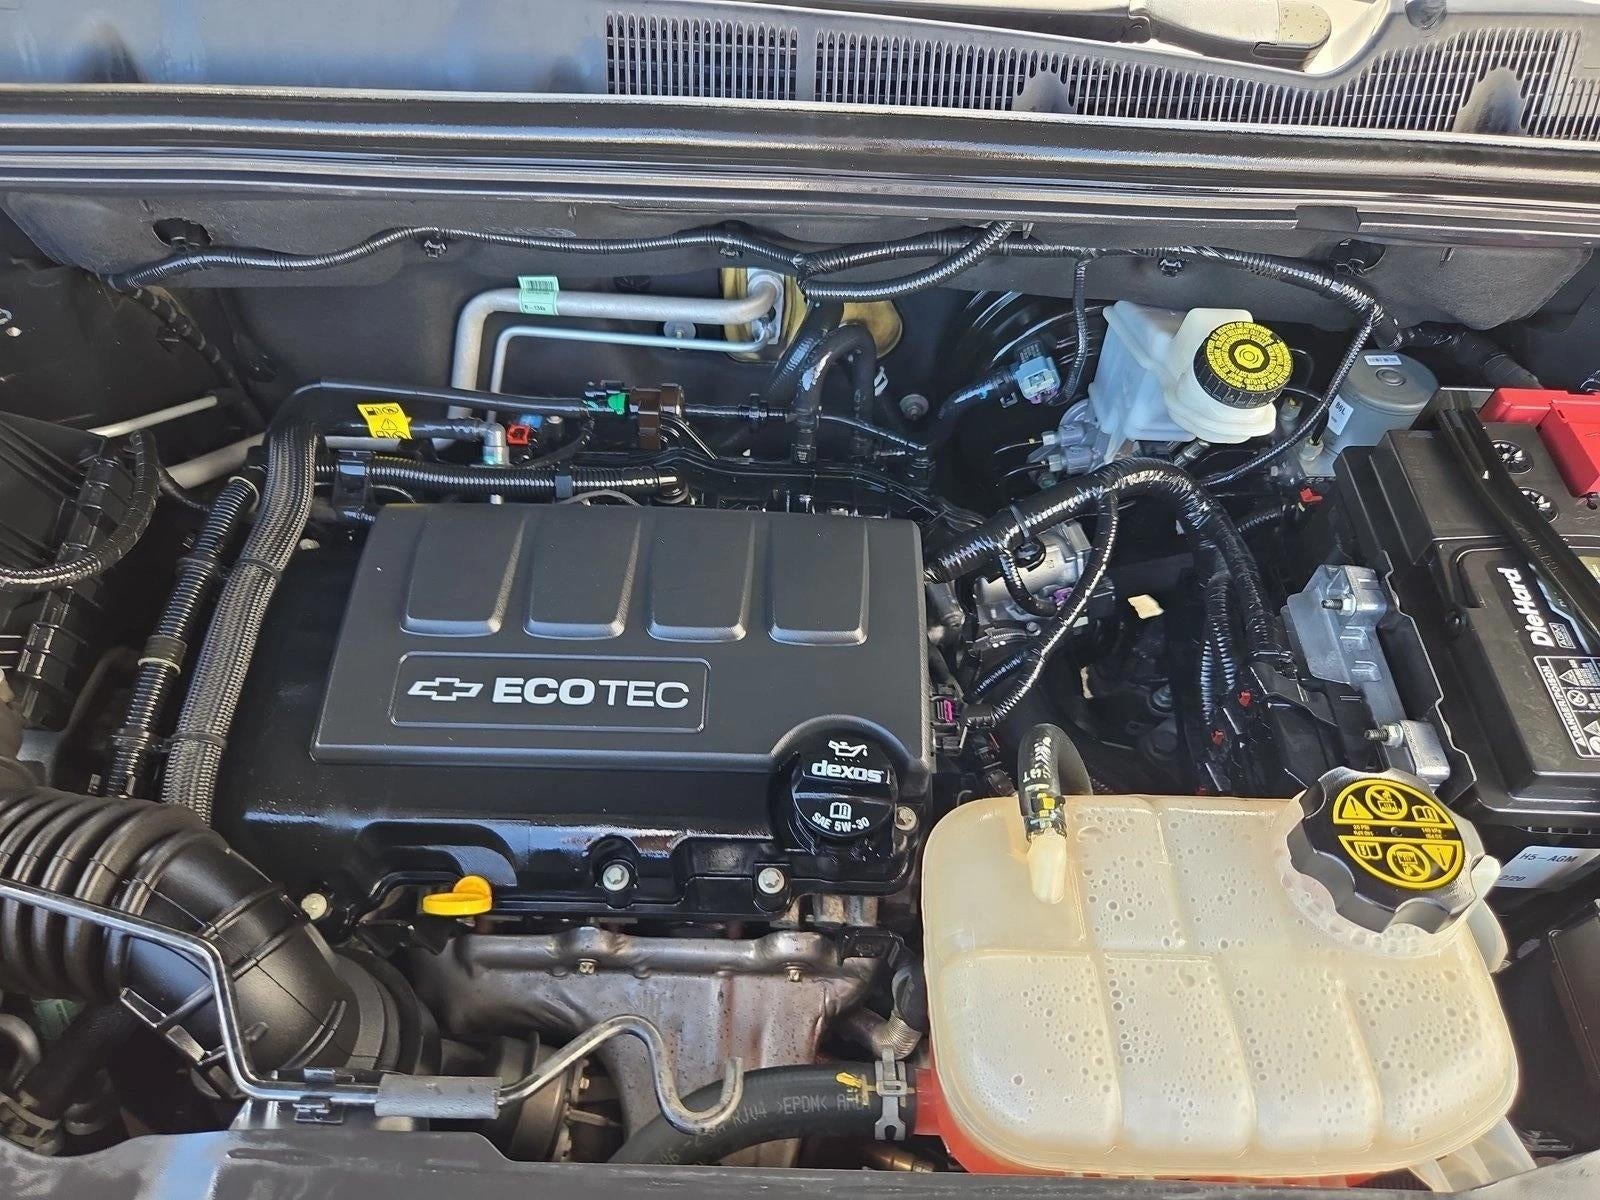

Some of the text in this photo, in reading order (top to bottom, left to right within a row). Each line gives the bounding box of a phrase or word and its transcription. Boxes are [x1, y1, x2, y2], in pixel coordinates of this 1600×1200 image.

[1497, 567, 1555, 647] DieHard
[492, 677, 690, 708] ECOTEC
[812, 812, 870, 833] SAE 5W-30
